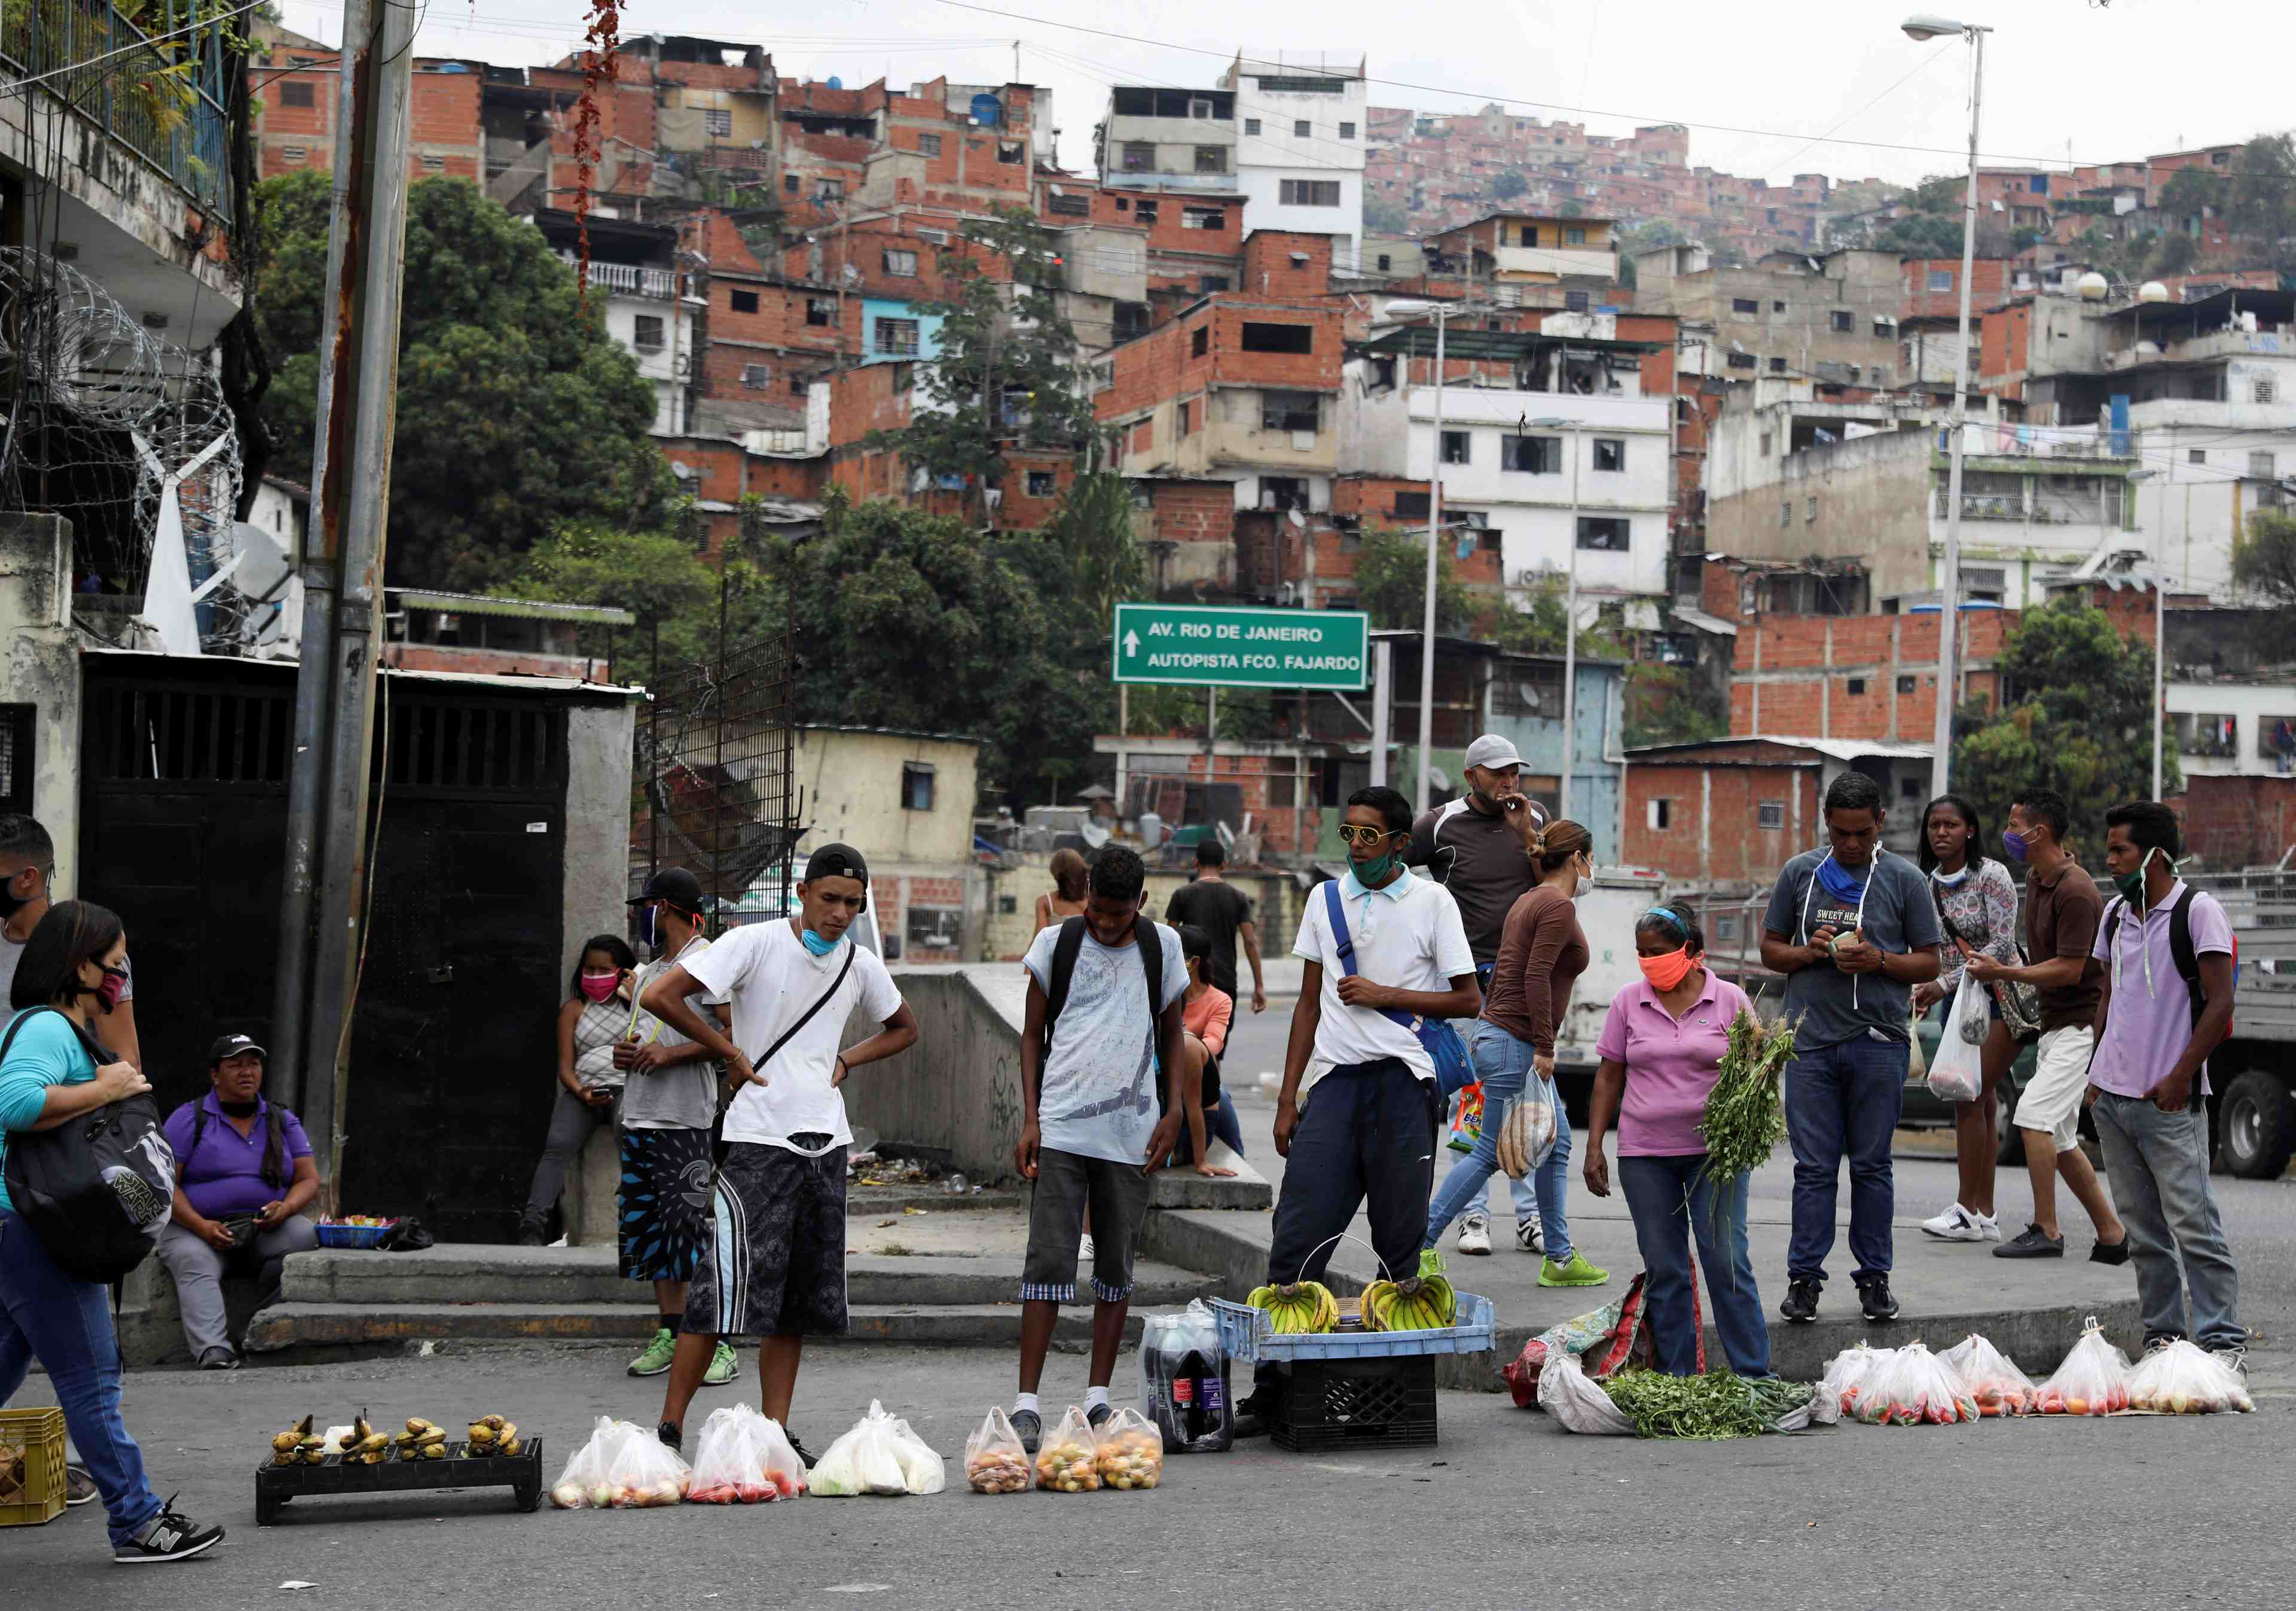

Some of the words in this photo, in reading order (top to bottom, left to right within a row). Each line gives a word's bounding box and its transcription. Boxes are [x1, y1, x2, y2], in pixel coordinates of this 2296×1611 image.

[1148, 623, 1175, 637] AV.
[1180, 624, 1213, 638] RIO
[1216, 625, 1240, 639] DE
[1244, 626, 1323, 642] JANEIRO
[1147, 654, 1238, 669] AUTOPISTA
[1242, 655, 1281, 670] FCO.
[1284, 655, 1360, 671] FAJARDO
[1816, 909, 1843, 920] SWEET
[1844, 912, 1864, 922] HEA
[114, 1176, 154, 1225] WARS
[120, 1171, 162, 1219] STAR
[148, 1527, 182, 1552] N
